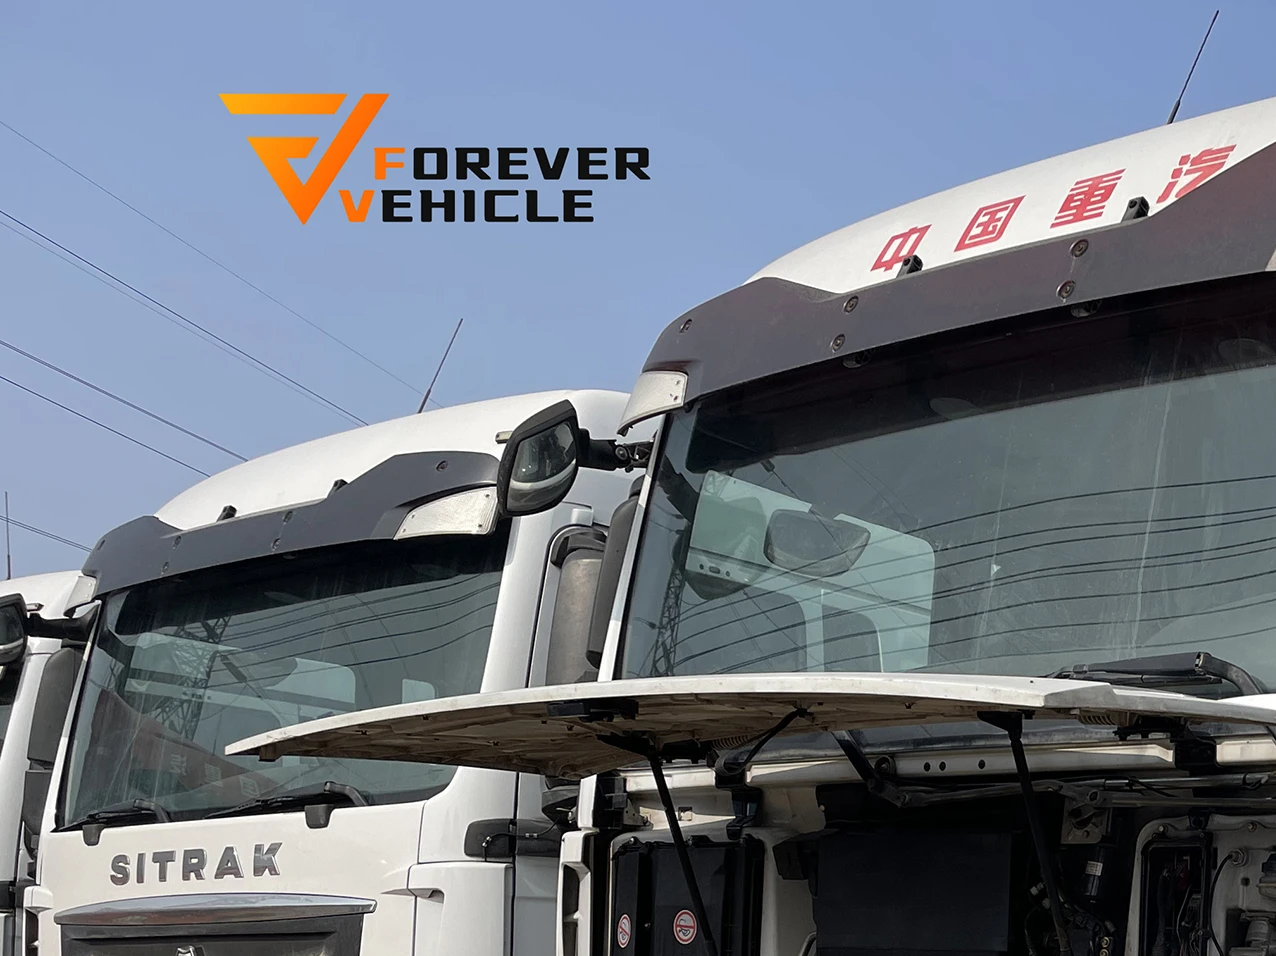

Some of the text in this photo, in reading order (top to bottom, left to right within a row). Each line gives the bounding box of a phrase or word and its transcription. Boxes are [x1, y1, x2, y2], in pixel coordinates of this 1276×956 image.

[870, 144, 1237, 272] 中国重汽
[109, 842, 283, 886] SITRAK
